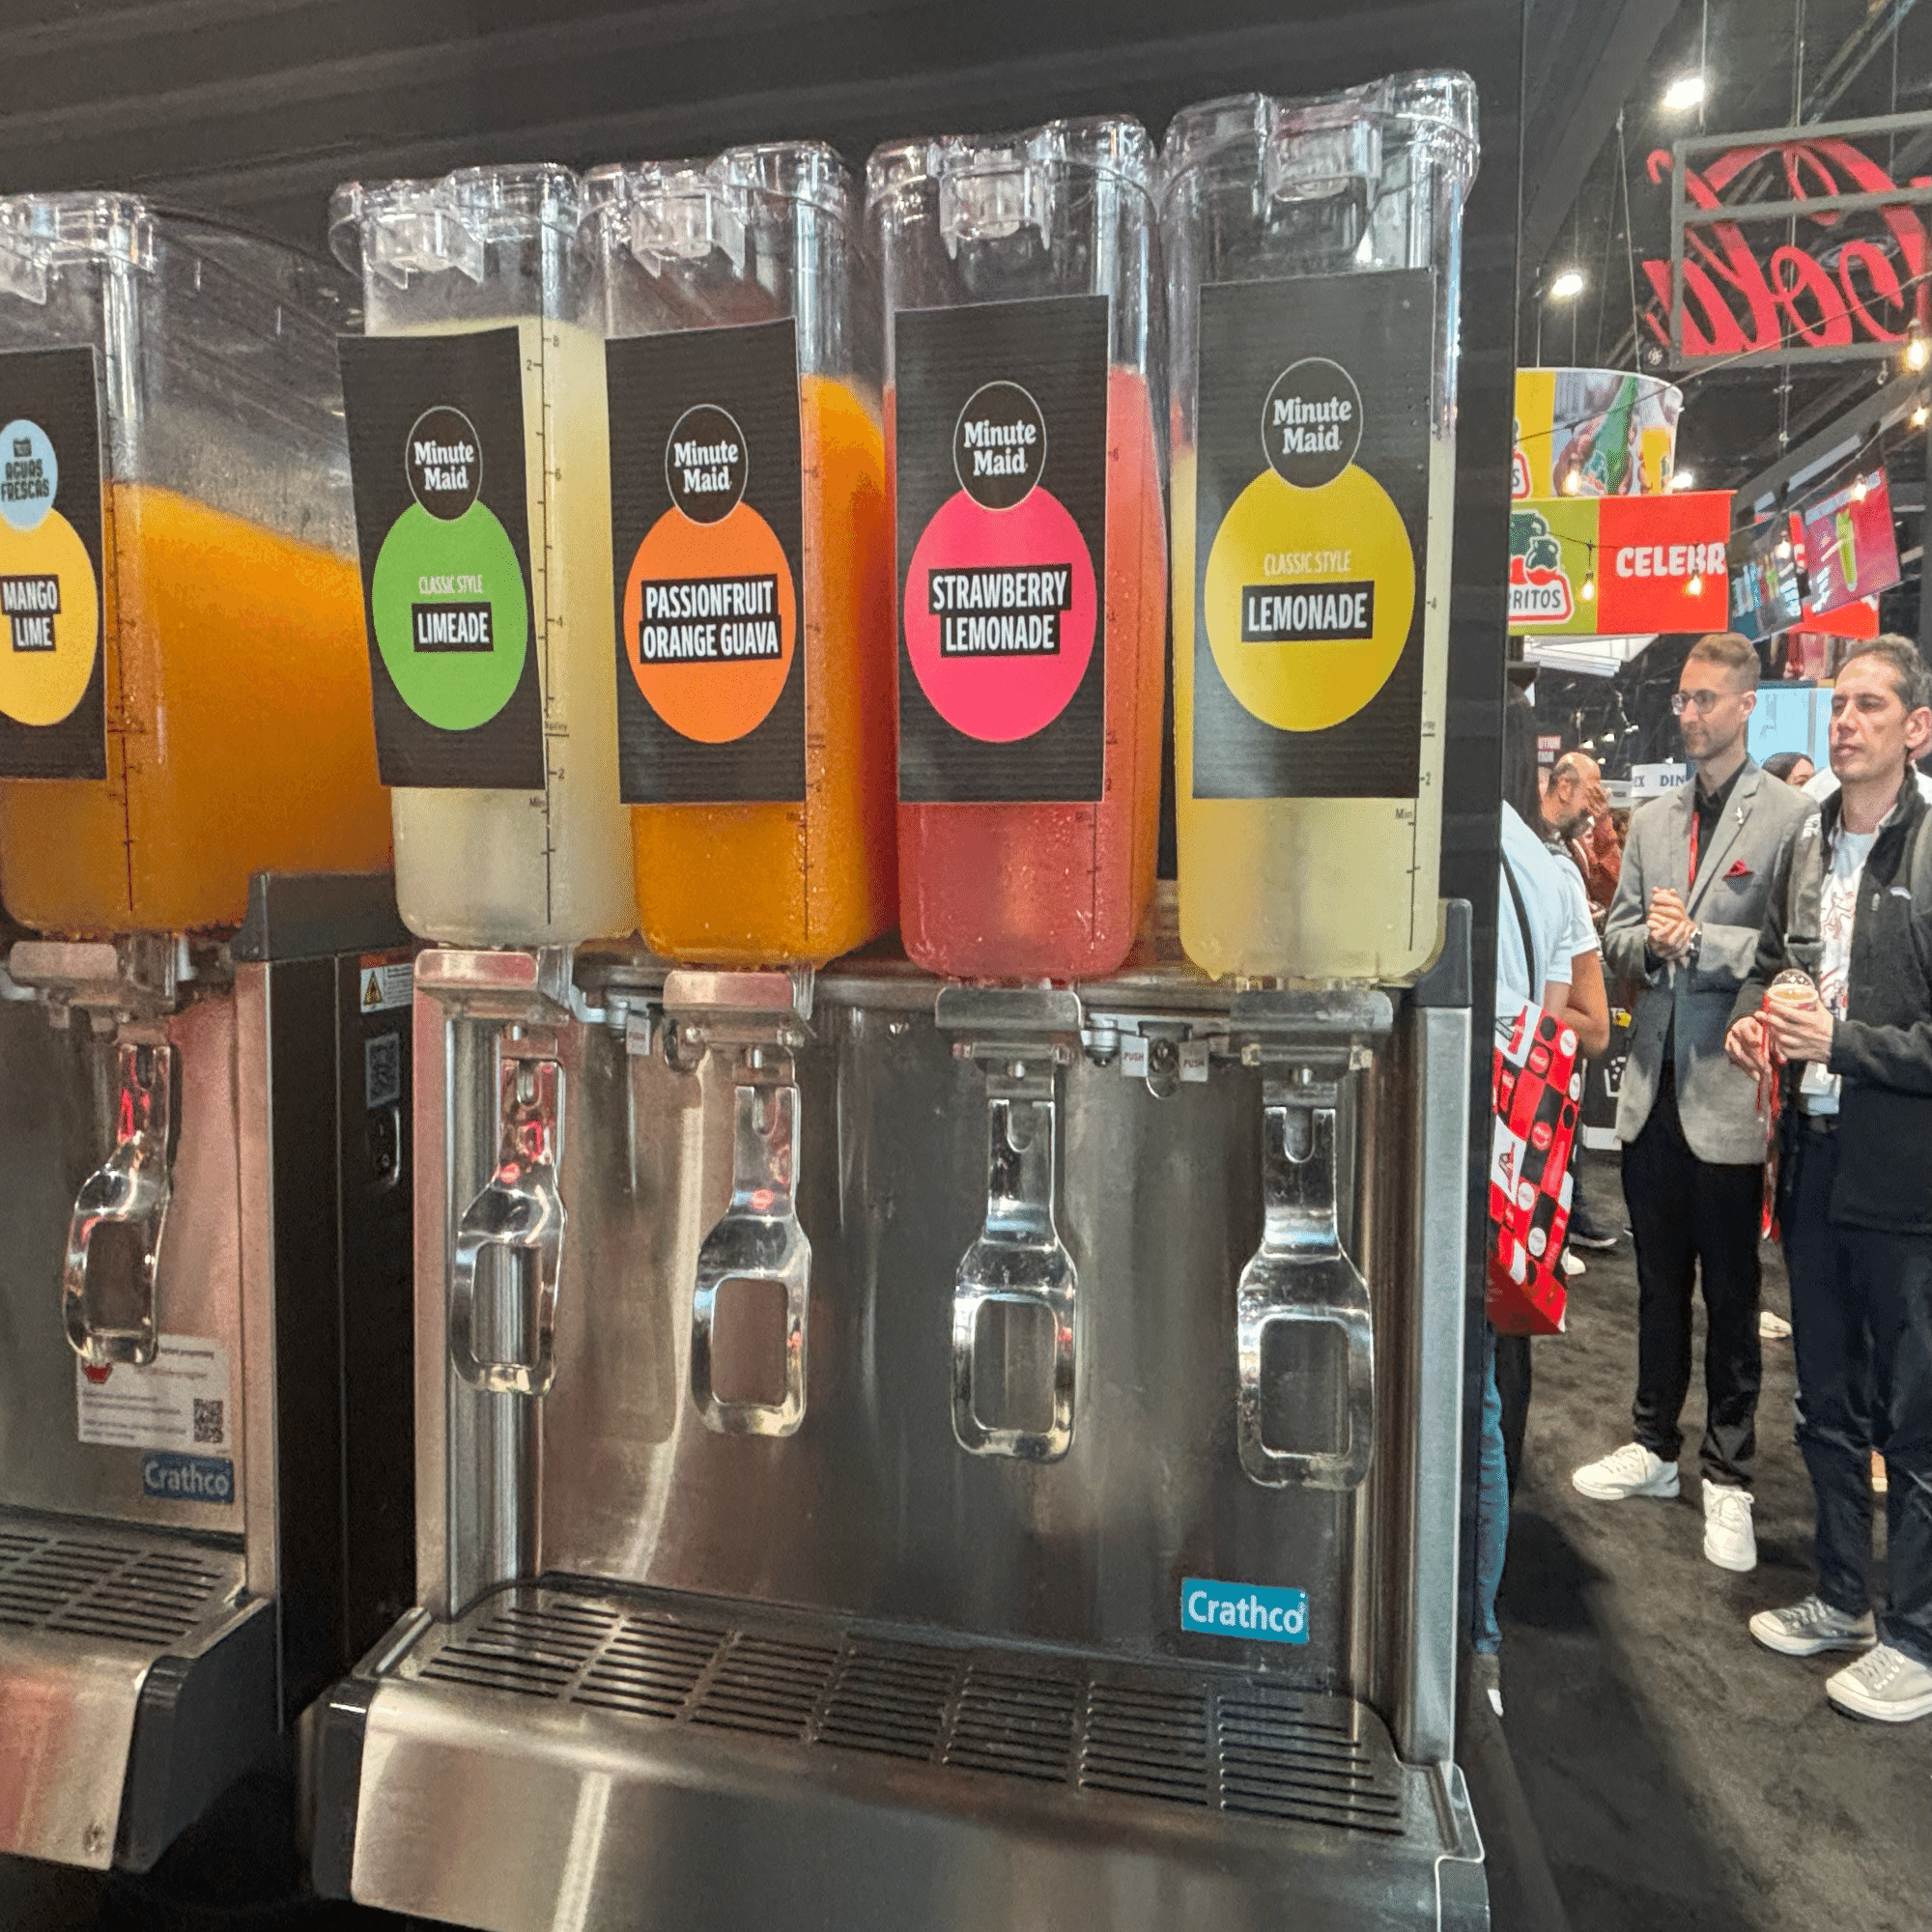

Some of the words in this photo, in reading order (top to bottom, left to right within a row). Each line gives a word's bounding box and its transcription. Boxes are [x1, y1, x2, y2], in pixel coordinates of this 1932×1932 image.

[1272, 396, 1352, 426] Minute
[963, 419, 1037, 448] Minute
[1282, 424, 1342, 455] Maid
[413, 440, 474, 466] Minute
[673, 440, 739, 468] Minute
[973, 447, 1027, 476] Maid
[423, 465, 469, 491] Maid
[682, 465, 731, 493] Maid
[1263, 551, 1313, 577] CLASSIC
[1314, 549, 1352, 574] STYLE
[2, 580, 58, 611] MANGO
[418, 574, 456, 594] CLASSIC
[456, 574, 484, 594] STYLE
[932, 570, 1067, 611] STRAWBERRY
[1507, 588, 1561, 610] RITOS
[645, 581, 774, 619] PASSIONFRUIT
[1248, 592, 1368, 632] LEMONADE
[14, 616, 53, 647] LIME
[417, 611, 490, 644] LIMEADE
[642, 624, 717, 659] ORANGE
[720, 620, 779, 656] GUAVA
[945, 614, 1055, 651] LEMONADE
[1123, 1052, 1145, 1062] PUSH
[145, 1462, 229, 1494] Crathco
[1188, 1589, 1304, 1634] Crathco
